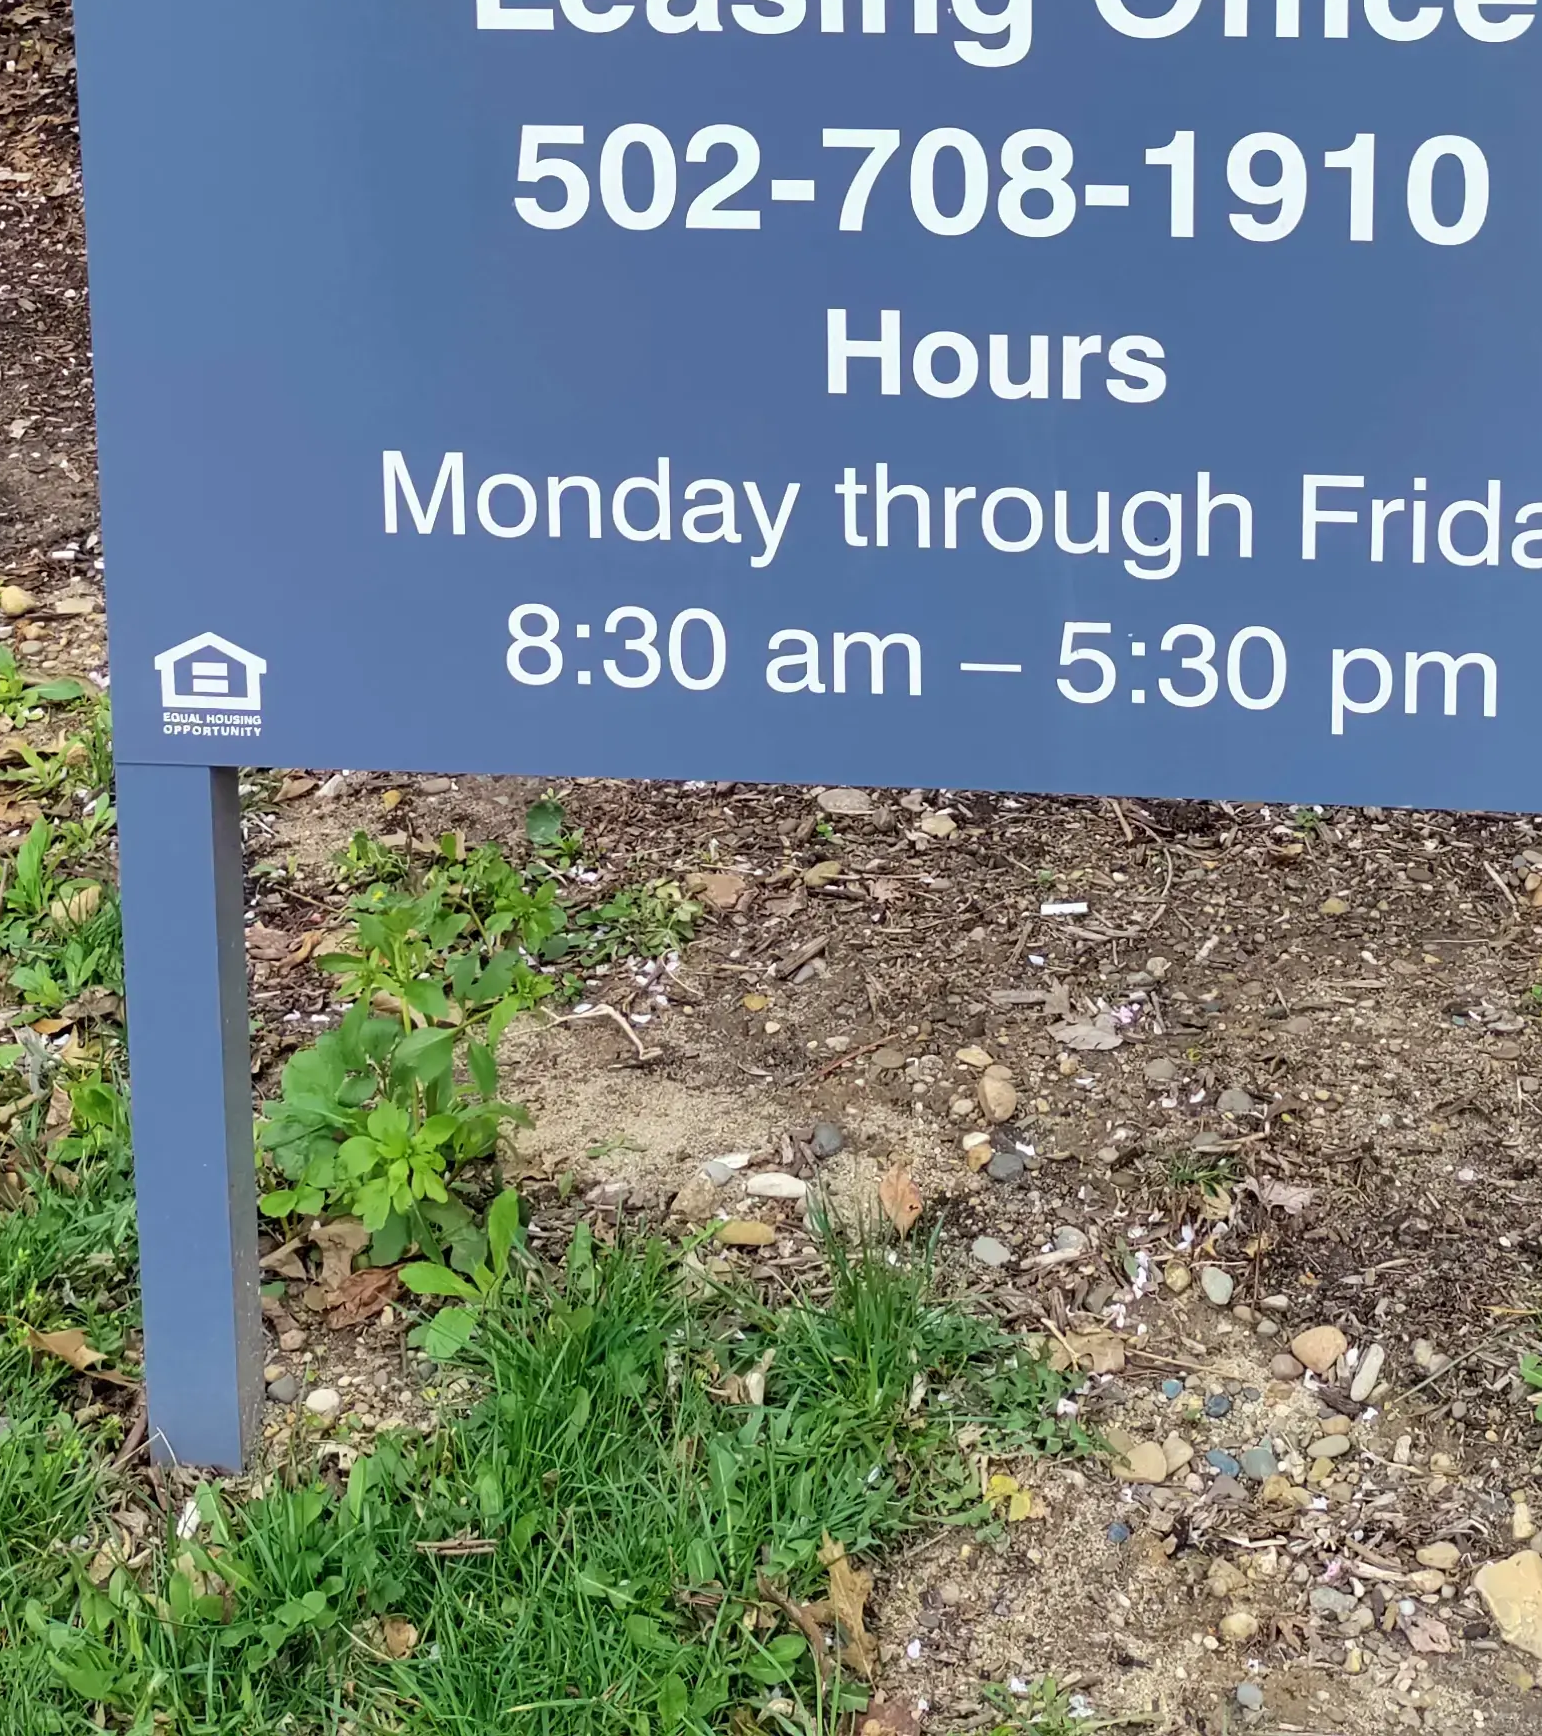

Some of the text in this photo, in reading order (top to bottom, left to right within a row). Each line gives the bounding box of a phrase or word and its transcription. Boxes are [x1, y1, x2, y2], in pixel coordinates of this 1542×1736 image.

[514, 123, 1490, 246] 502-708-1910
[827, 308, 1167, 403] Hours
[382, 450, 801, 568] Monday
[834, 462, 1253, 580] through
[163, 712, 262, 725] EQUAL HOUSING
[506, 603, 727, 691] 8:30
[766, 629, 923, 696] am
[1056, 621, 1287, 710] 5:30
[1331, 648, 1498, 735] pm
[163, 725, 262, 736] OPPORTUNITY
